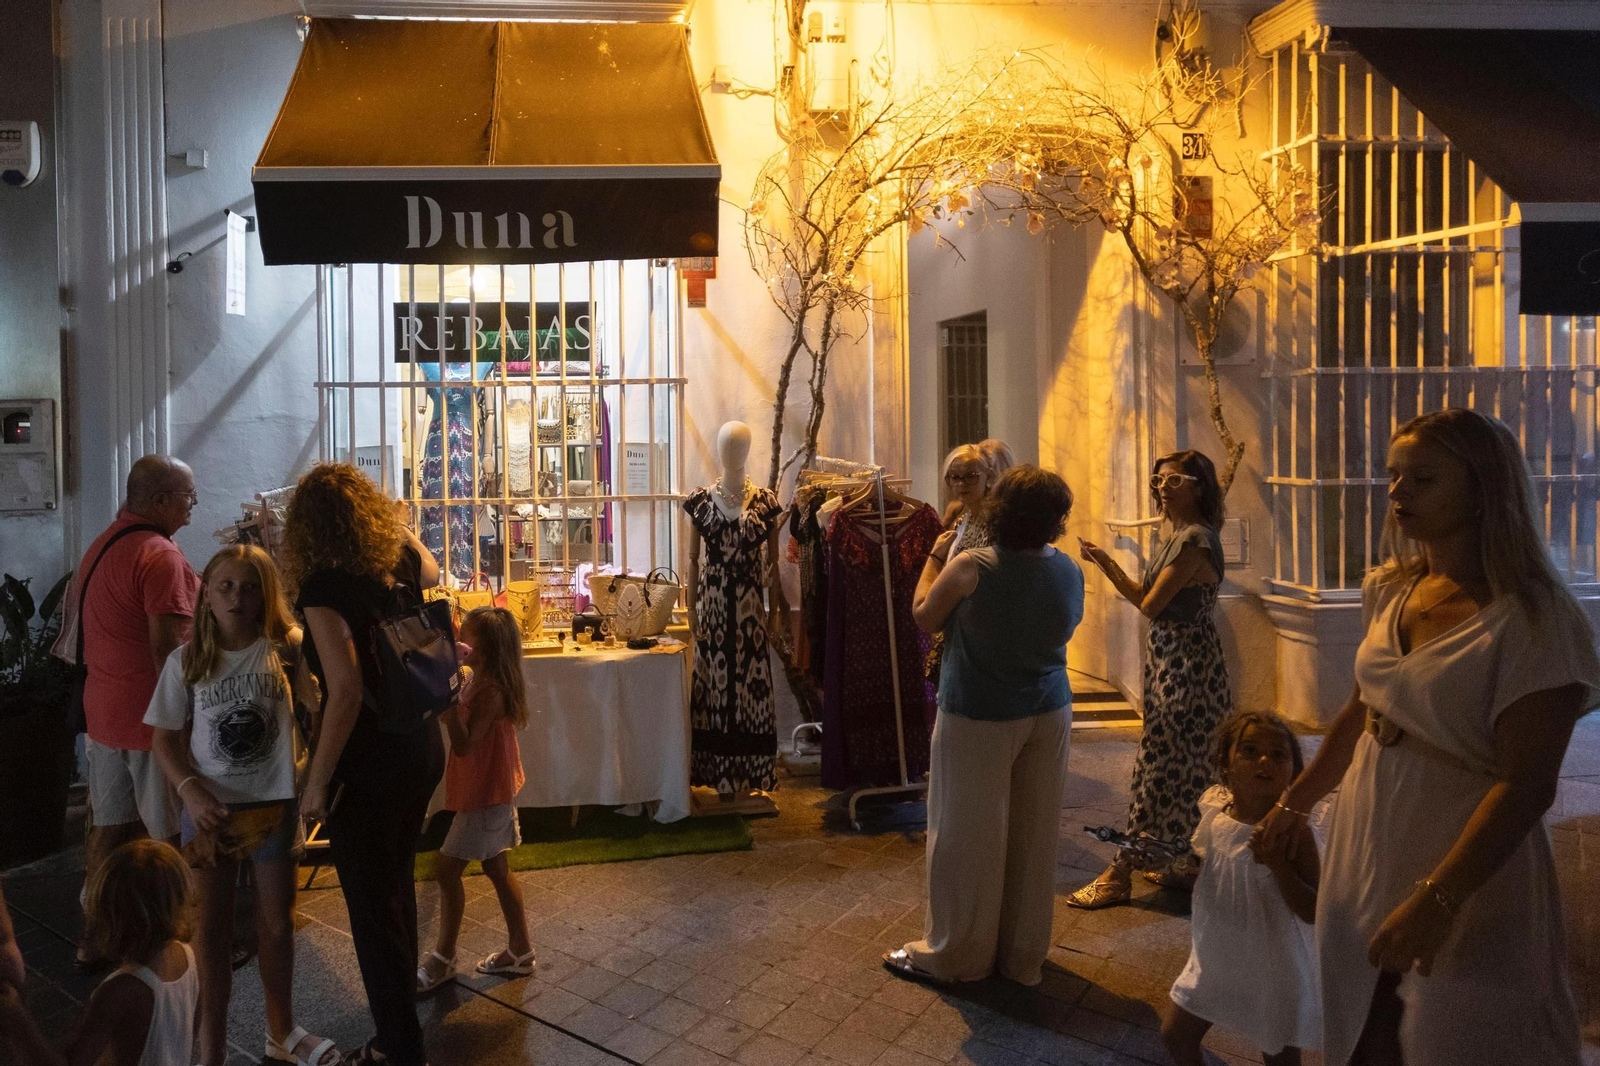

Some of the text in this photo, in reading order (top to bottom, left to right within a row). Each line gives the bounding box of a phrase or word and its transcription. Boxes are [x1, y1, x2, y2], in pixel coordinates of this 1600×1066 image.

[404, 195, 578, 249] Duna
[398, 315, 592, 361] REBAJAS
[201, 672, 285, 711] BASERUNNERS
